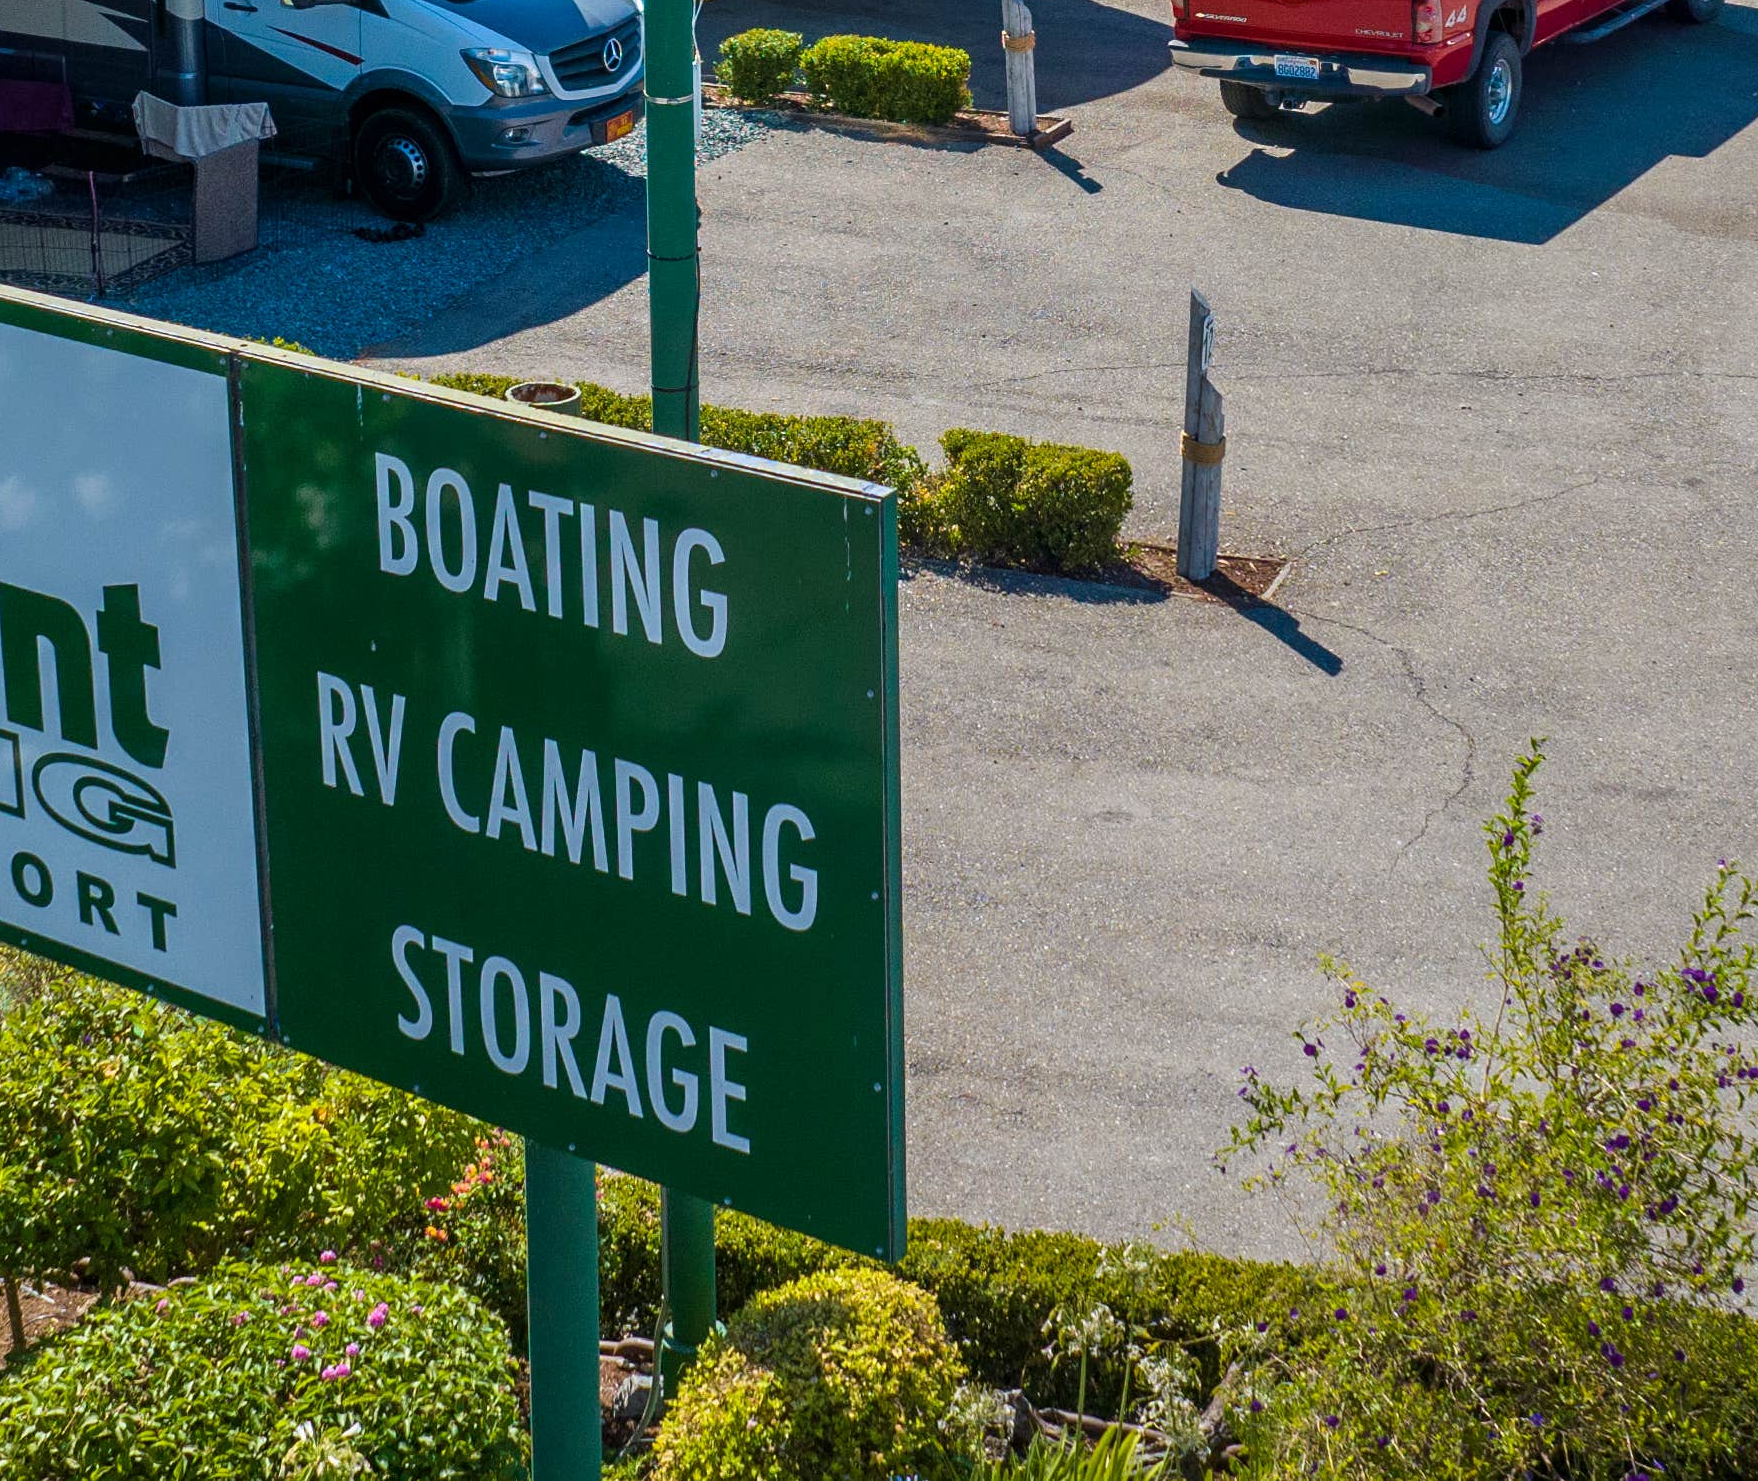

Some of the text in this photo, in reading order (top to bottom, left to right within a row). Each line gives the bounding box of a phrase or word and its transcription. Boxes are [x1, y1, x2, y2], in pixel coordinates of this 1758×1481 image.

[1355, 28, 1404, 38] CHEVROLET
[375, 451, 728, 657] BOATING
[317, 670, 818, 932] RV CAMPING
[391, 924, 751, 1154] STORAGE
